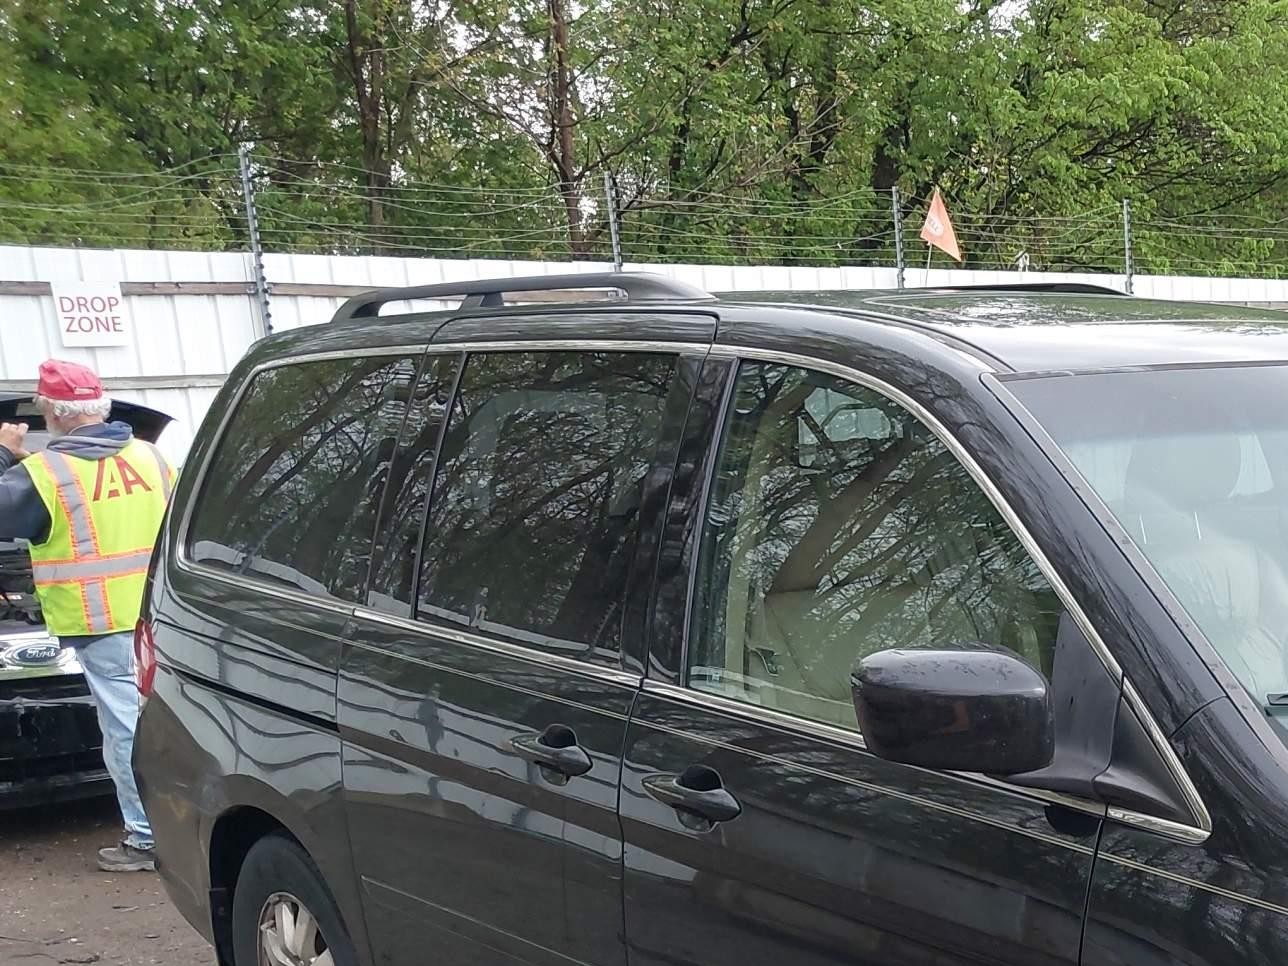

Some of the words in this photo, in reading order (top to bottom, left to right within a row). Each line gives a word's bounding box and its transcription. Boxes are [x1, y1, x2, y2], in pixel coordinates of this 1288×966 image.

[59, 296, 119, 313] DROP
[64, 316, 124, 333] ZONE
[26, 646, 56, 659] Ford
